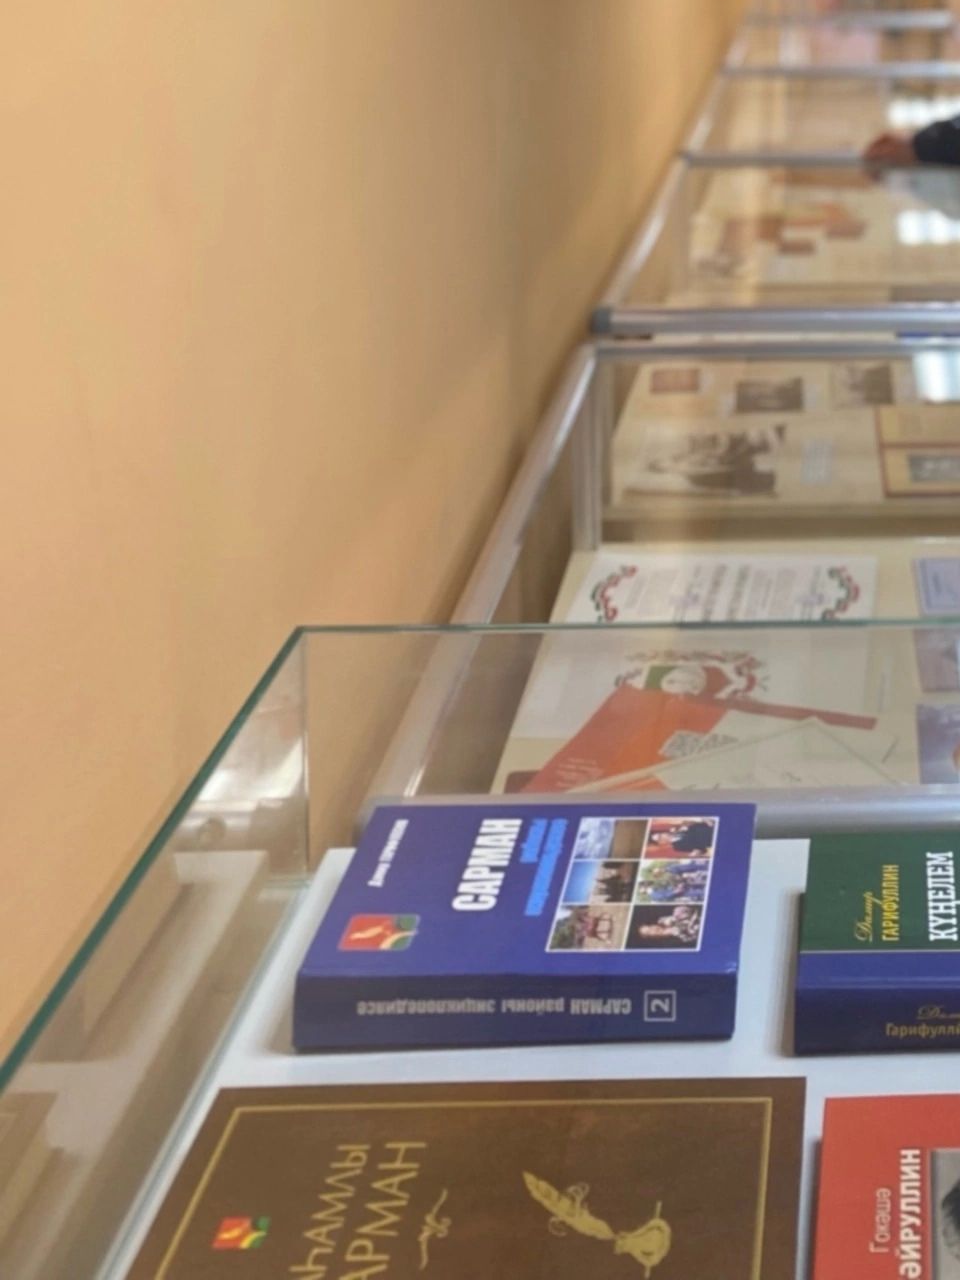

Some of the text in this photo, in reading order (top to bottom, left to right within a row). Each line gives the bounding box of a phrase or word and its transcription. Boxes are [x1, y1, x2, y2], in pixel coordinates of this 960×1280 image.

[451, 818, 523, 911] САРМАН
[881, 864, 900, 942] ГАРИФУЛЛИН
[570, 998, 632, 1015] САРМАН
[894, 1149, 922, 1280] ӘЙРУЛЛИН
